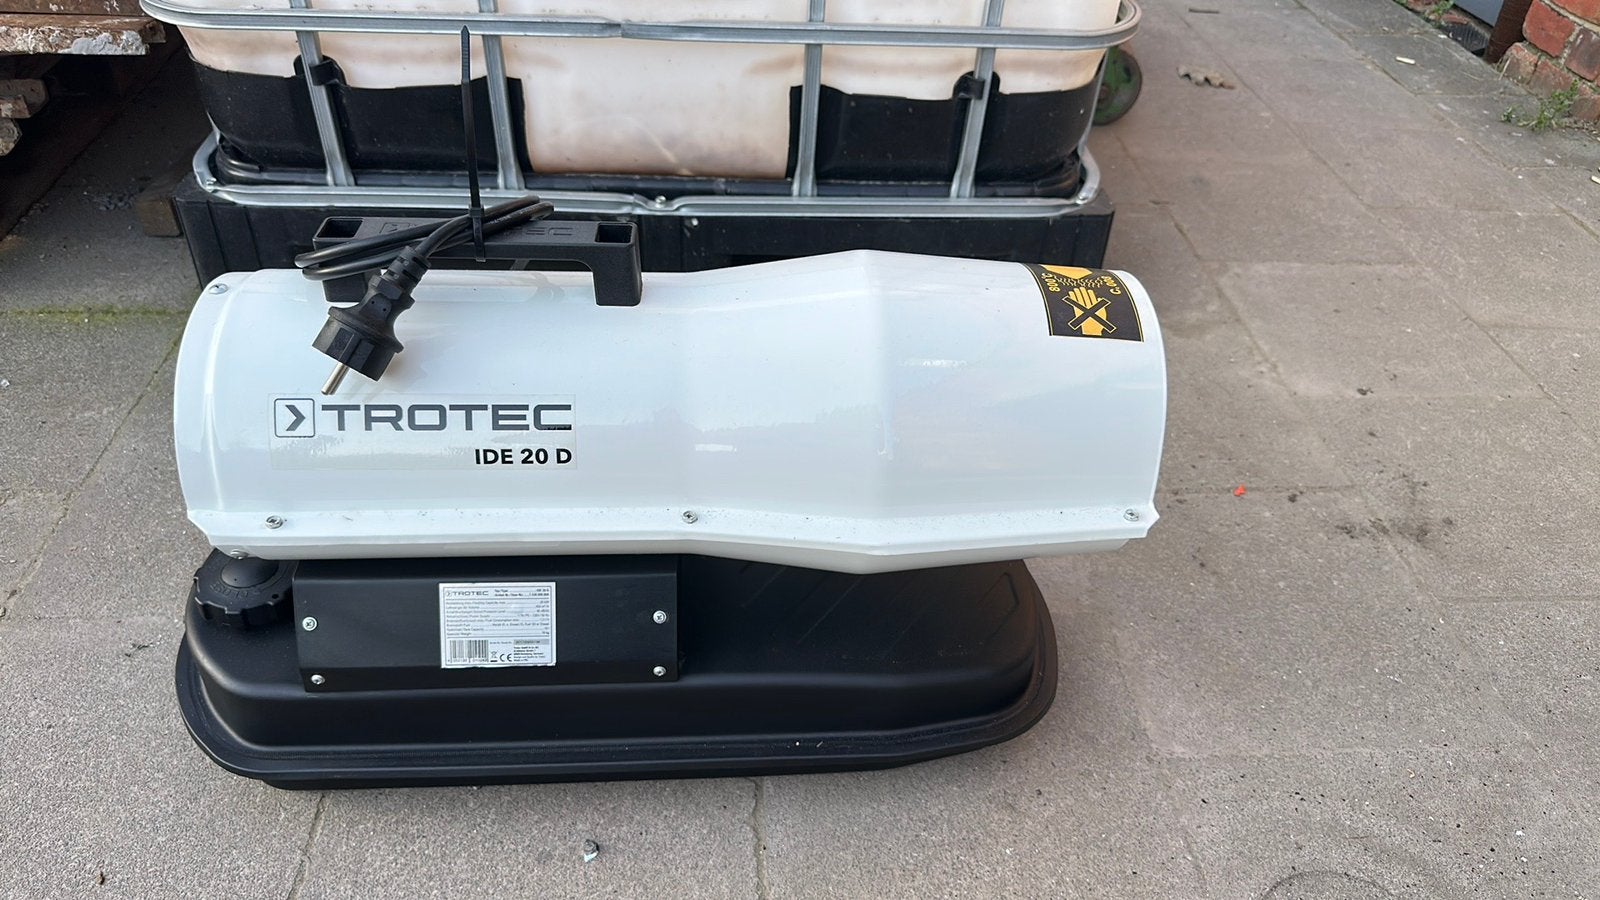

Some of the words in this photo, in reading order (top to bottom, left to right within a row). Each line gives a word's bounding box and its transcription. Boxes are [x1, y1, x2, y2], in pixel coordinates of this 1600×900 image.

[321, 404, 572, 430] TROTEC
[475, 448, 514, 465] IDE
[520, 448, 548, 465] 20
[556, 448, 572, 465] D
